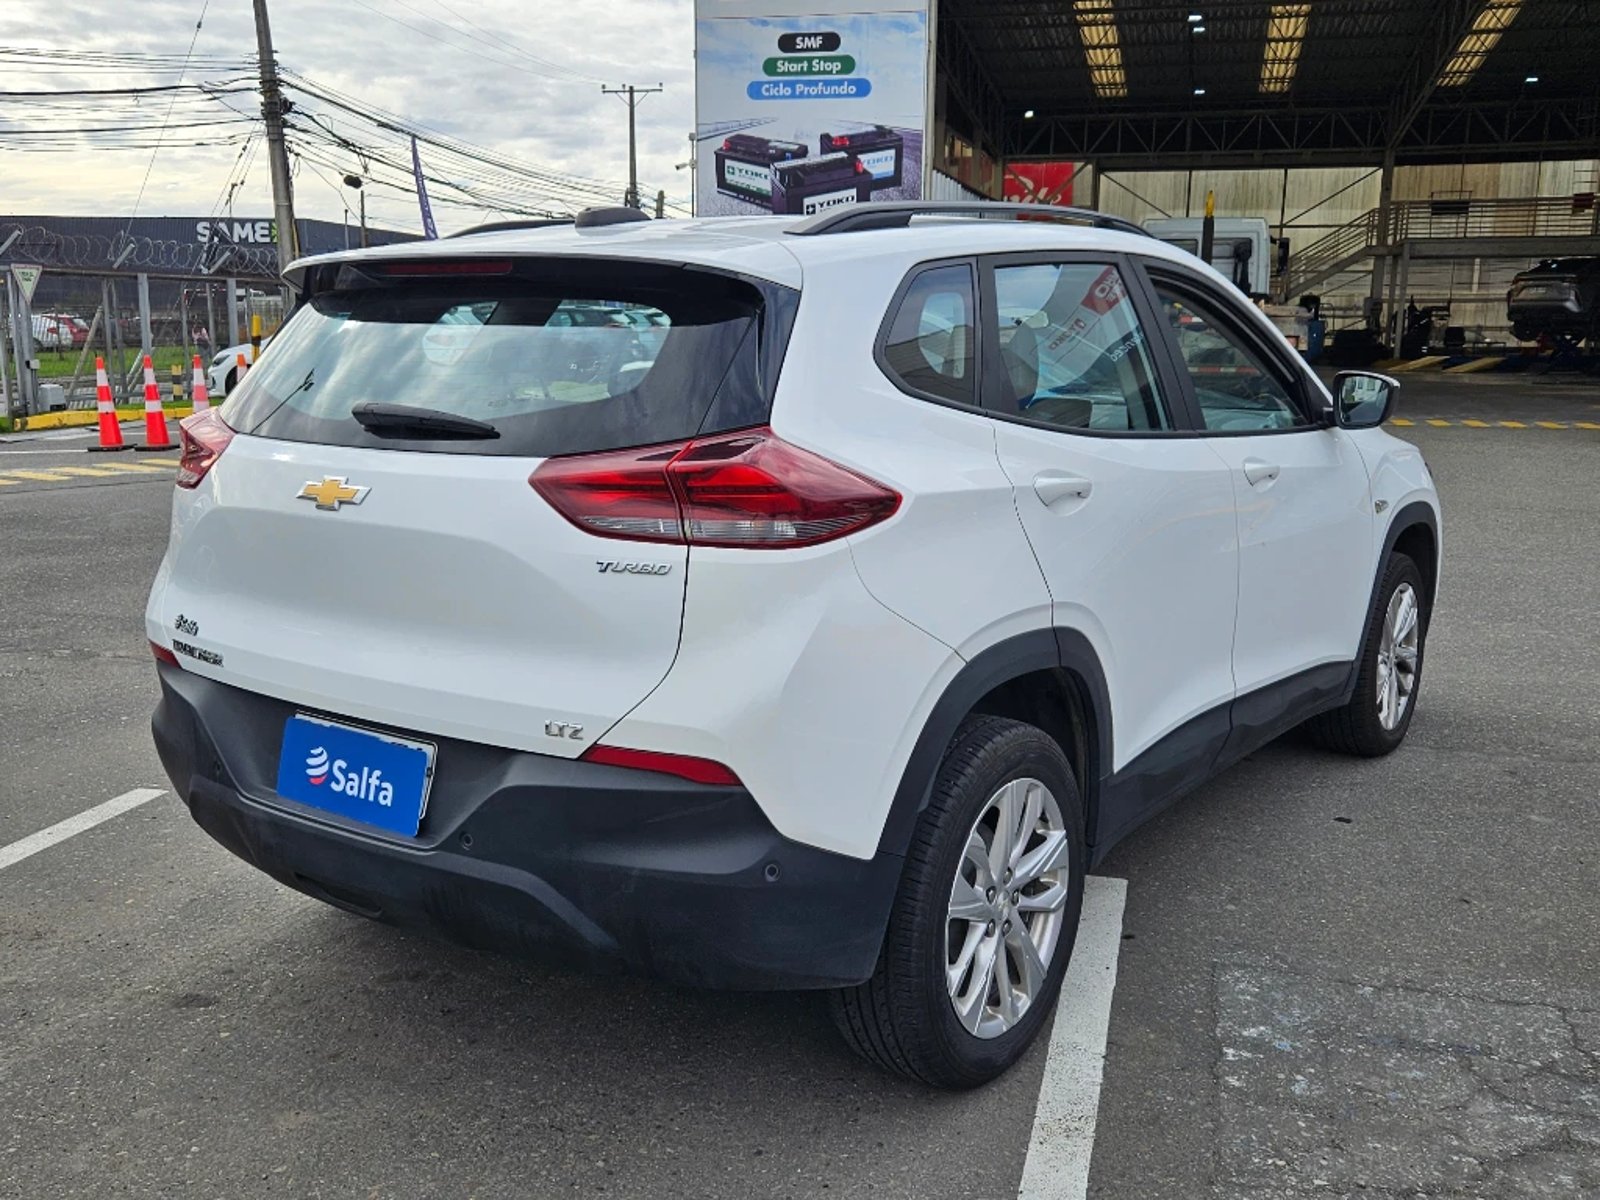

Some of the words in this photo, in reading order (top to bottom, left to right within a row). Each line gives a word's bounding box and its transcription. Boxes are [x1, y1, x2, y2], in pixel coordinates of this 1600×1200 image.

[795, 36, 823, 50] SMF
[776, 60, 808, 73] Start
[812, 59, 842, 74] Stop
[761, 84, 792, 97] Ciclo
[796, 82, 857, 96] Profundo
[596, 560, 673, 576] TURBO
[544, 720, 584, 741] LTZ
[330, 759, 394, 807] Salfa
